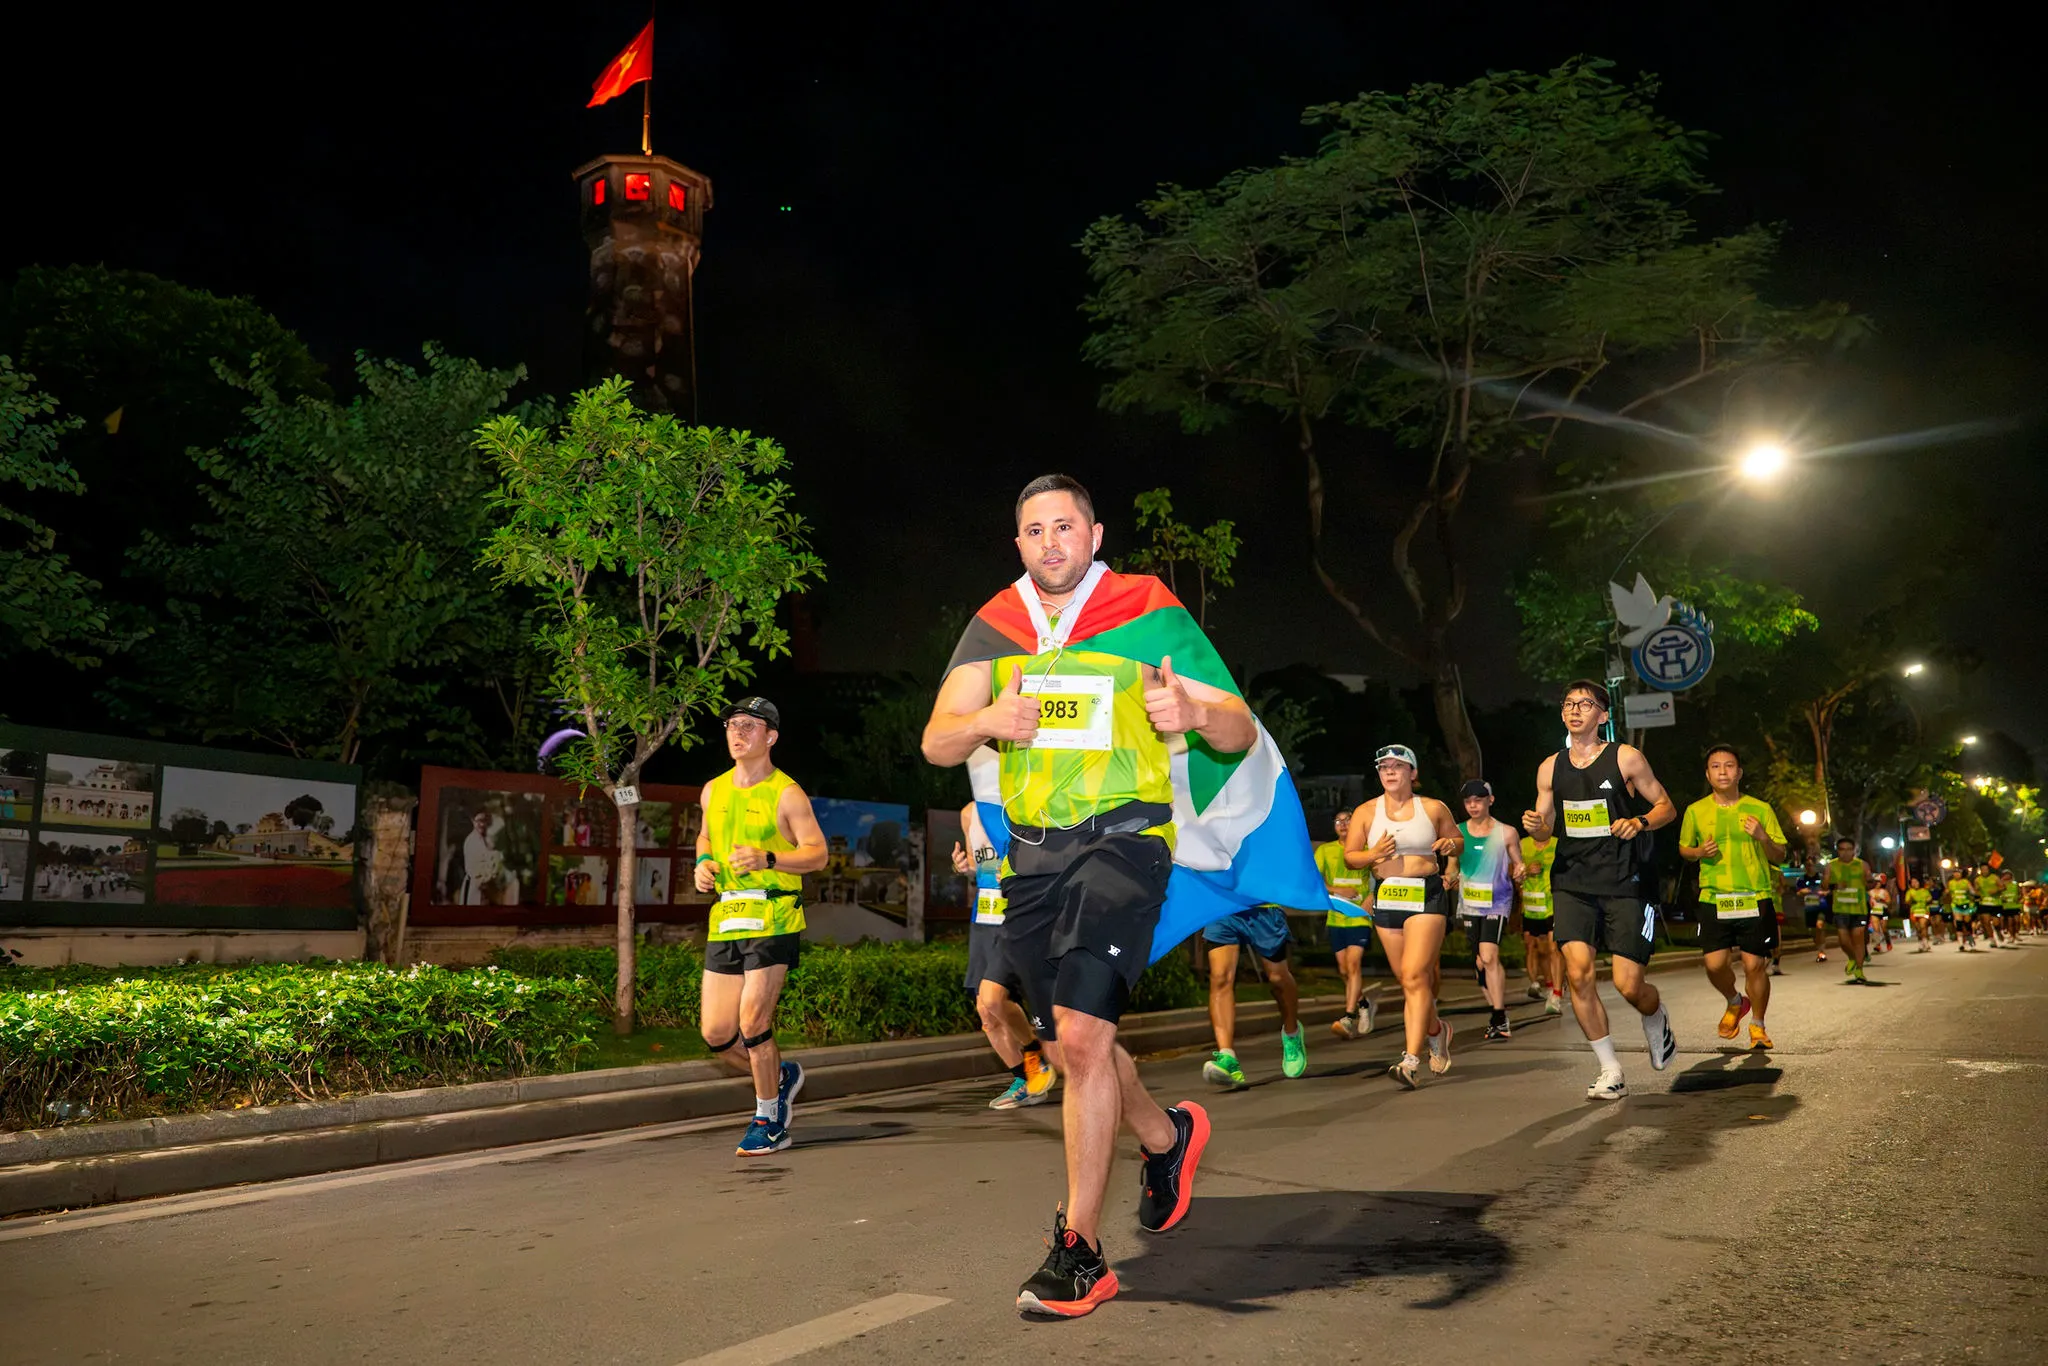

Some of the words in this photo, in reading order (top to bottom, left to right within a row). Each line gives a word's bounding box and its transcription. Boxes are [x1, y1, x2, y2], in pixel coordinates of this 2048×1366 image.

[1039, 699, 1079, 719] 983
[619, 789, 634, 799] 116
[1566, 812, 1592, 823] 91994
[974, 846, 1000, 864] BID
[1382, 887, 1409, 897] 91517
